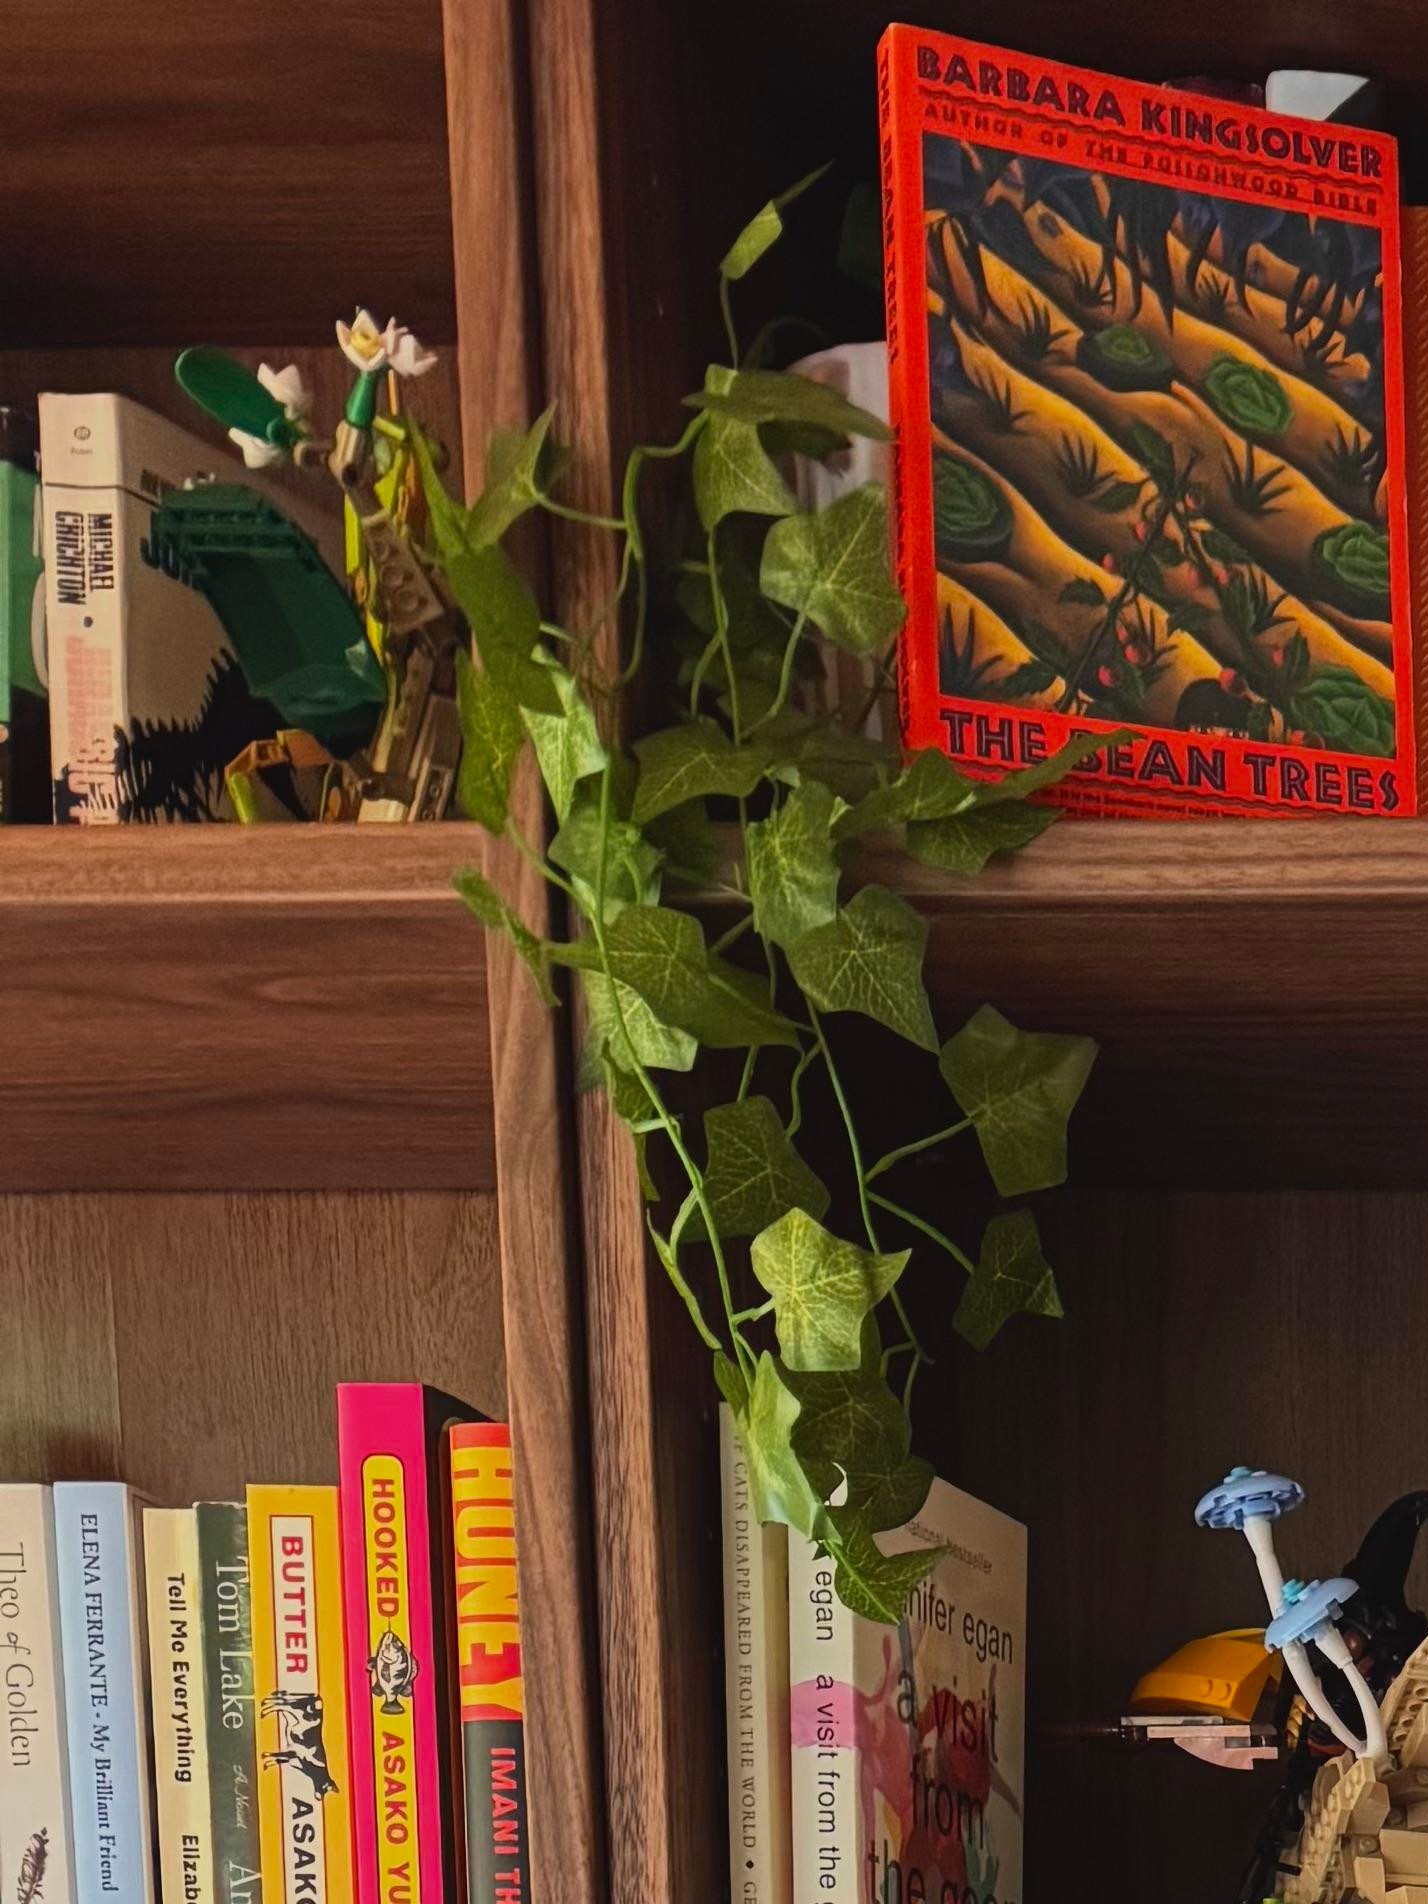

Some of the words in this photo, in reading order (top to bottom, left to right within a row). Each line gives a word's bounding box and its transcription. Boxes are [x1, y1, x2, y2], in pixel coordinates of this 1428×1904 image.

[918, 45, 1126, 127] BARBARA
[1142, 93, 1383, 179] KINGSOLVER
[923, 105, 1024, 141] AUTHOR
[1041, 126, 1068, 149] OF
[1086, 137, 1131, 163] THE
[1142, 150, 1298, 201] POISONWOOD
[1313, 186, 1378, 216] BIBLE
[56, 511, 86, 606] CRICHTON
[88, 513, 113, 594] MICHAEL
[280, 1534, 309, 1673] BUTTER
[816, 1672, 832, 1691] a
[816, 1703, 839, 1759] visit
[819, 1770, 836, 1836] from
[818, 1845, 836, 1889] the
